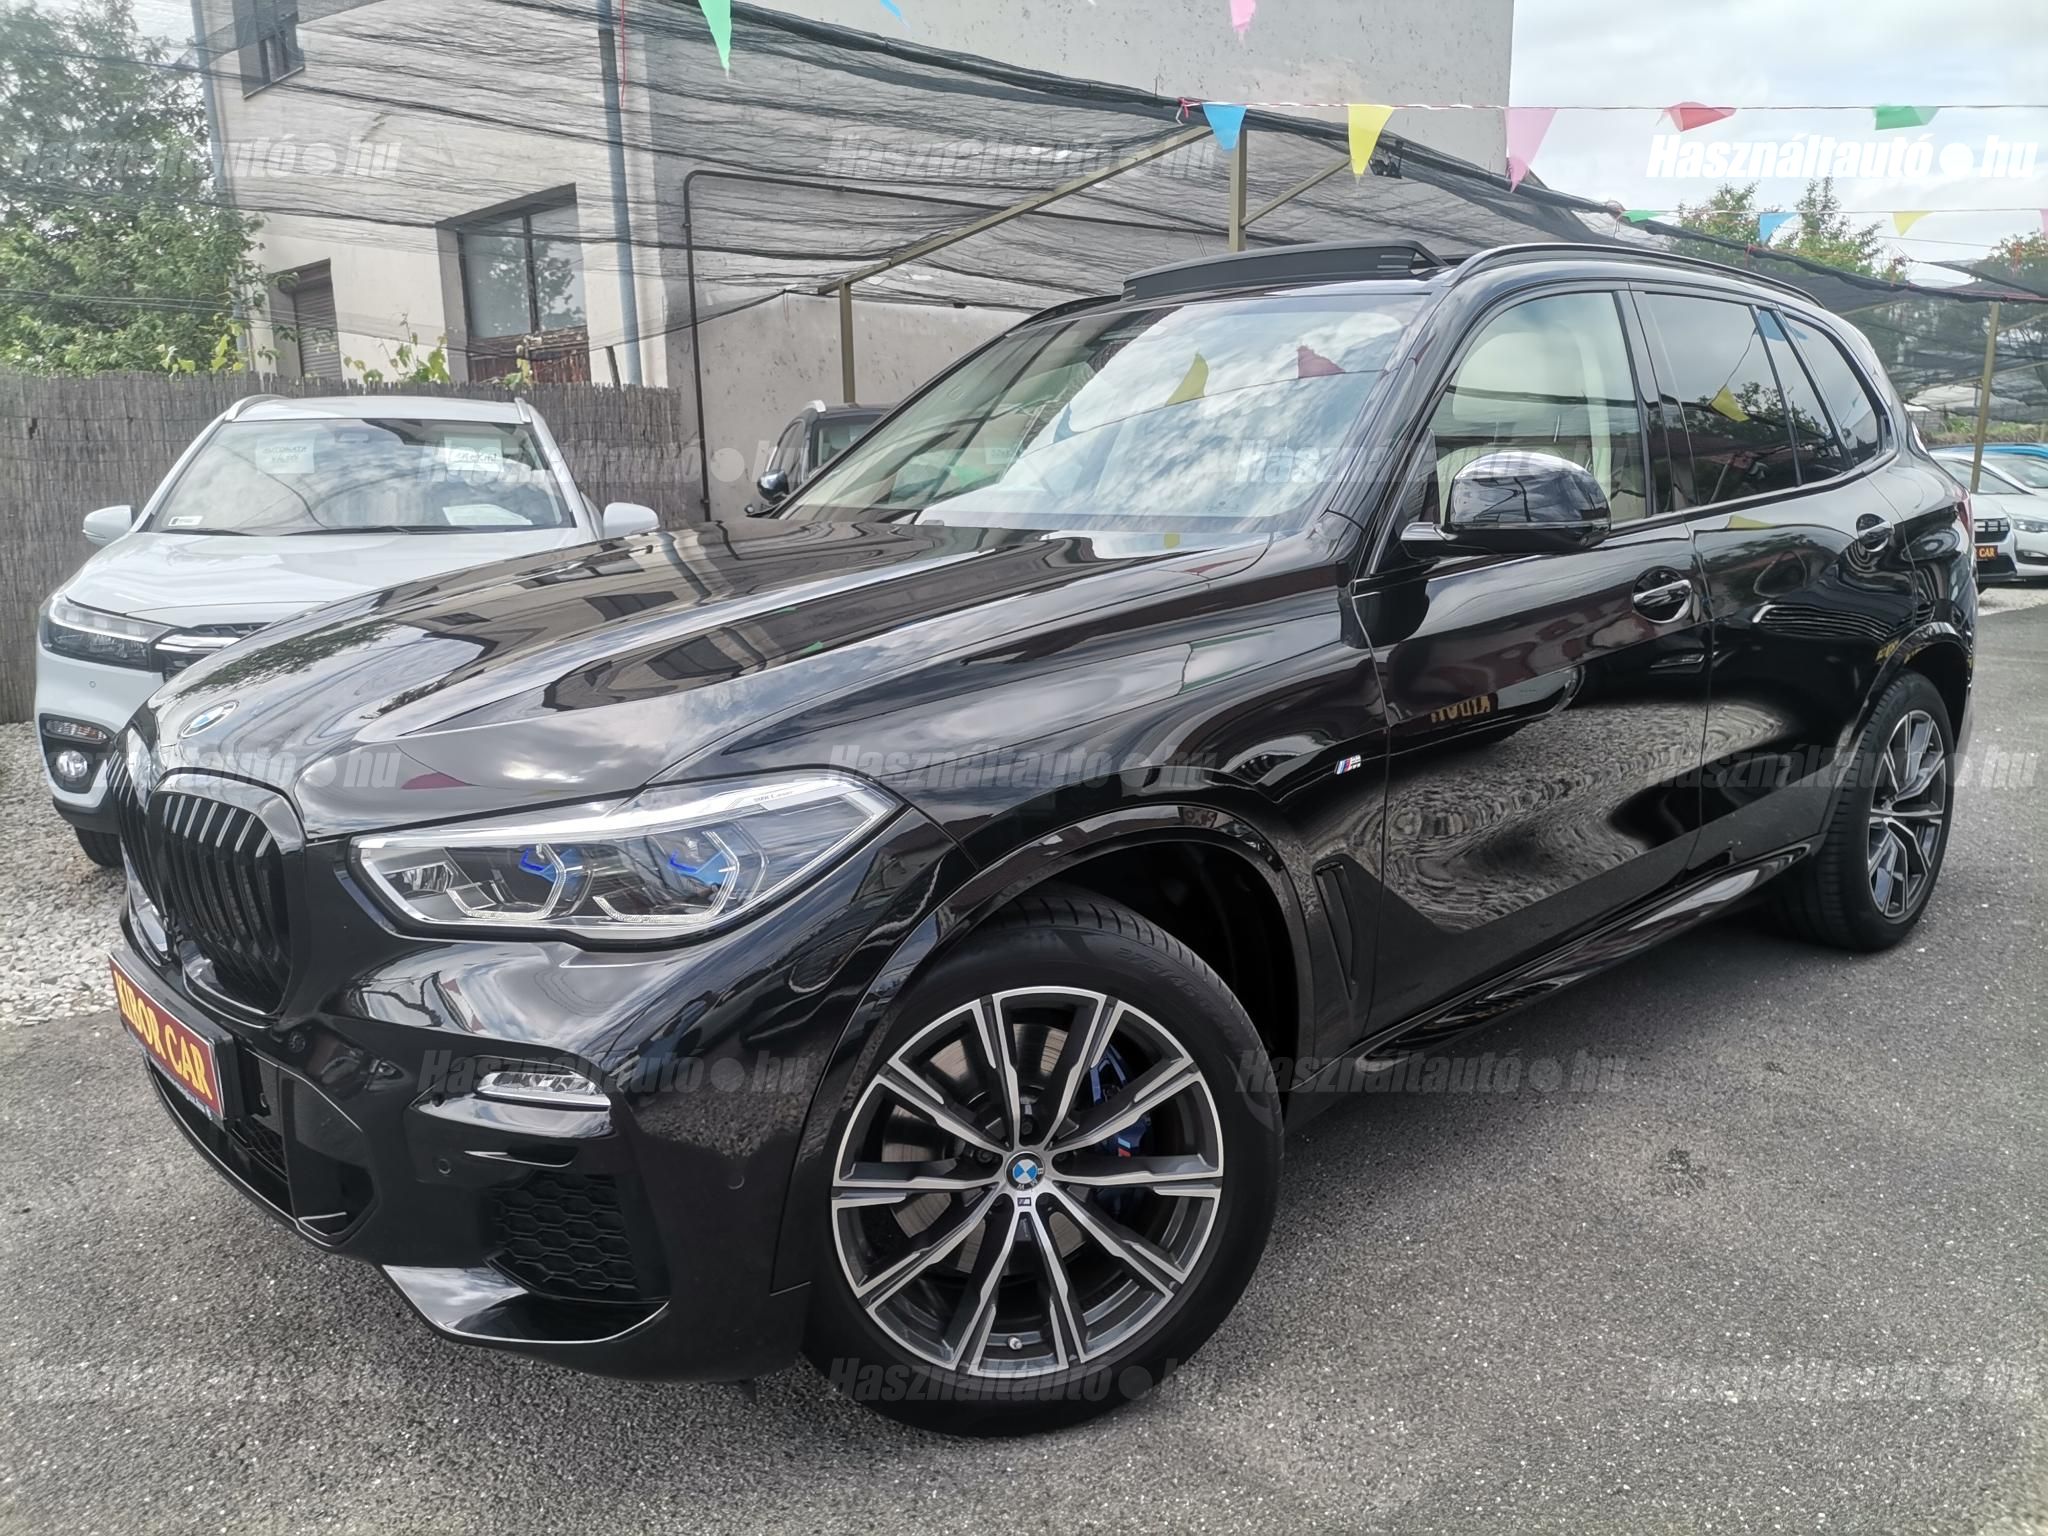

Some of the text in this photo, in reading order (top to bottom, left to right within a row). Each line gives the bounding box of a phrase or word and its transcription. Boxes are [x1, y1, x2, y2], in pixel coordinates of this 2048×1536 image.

[1979, 547, 1995, 557] CAR
[113, 969, 213, 1100] KIBOR CAR
